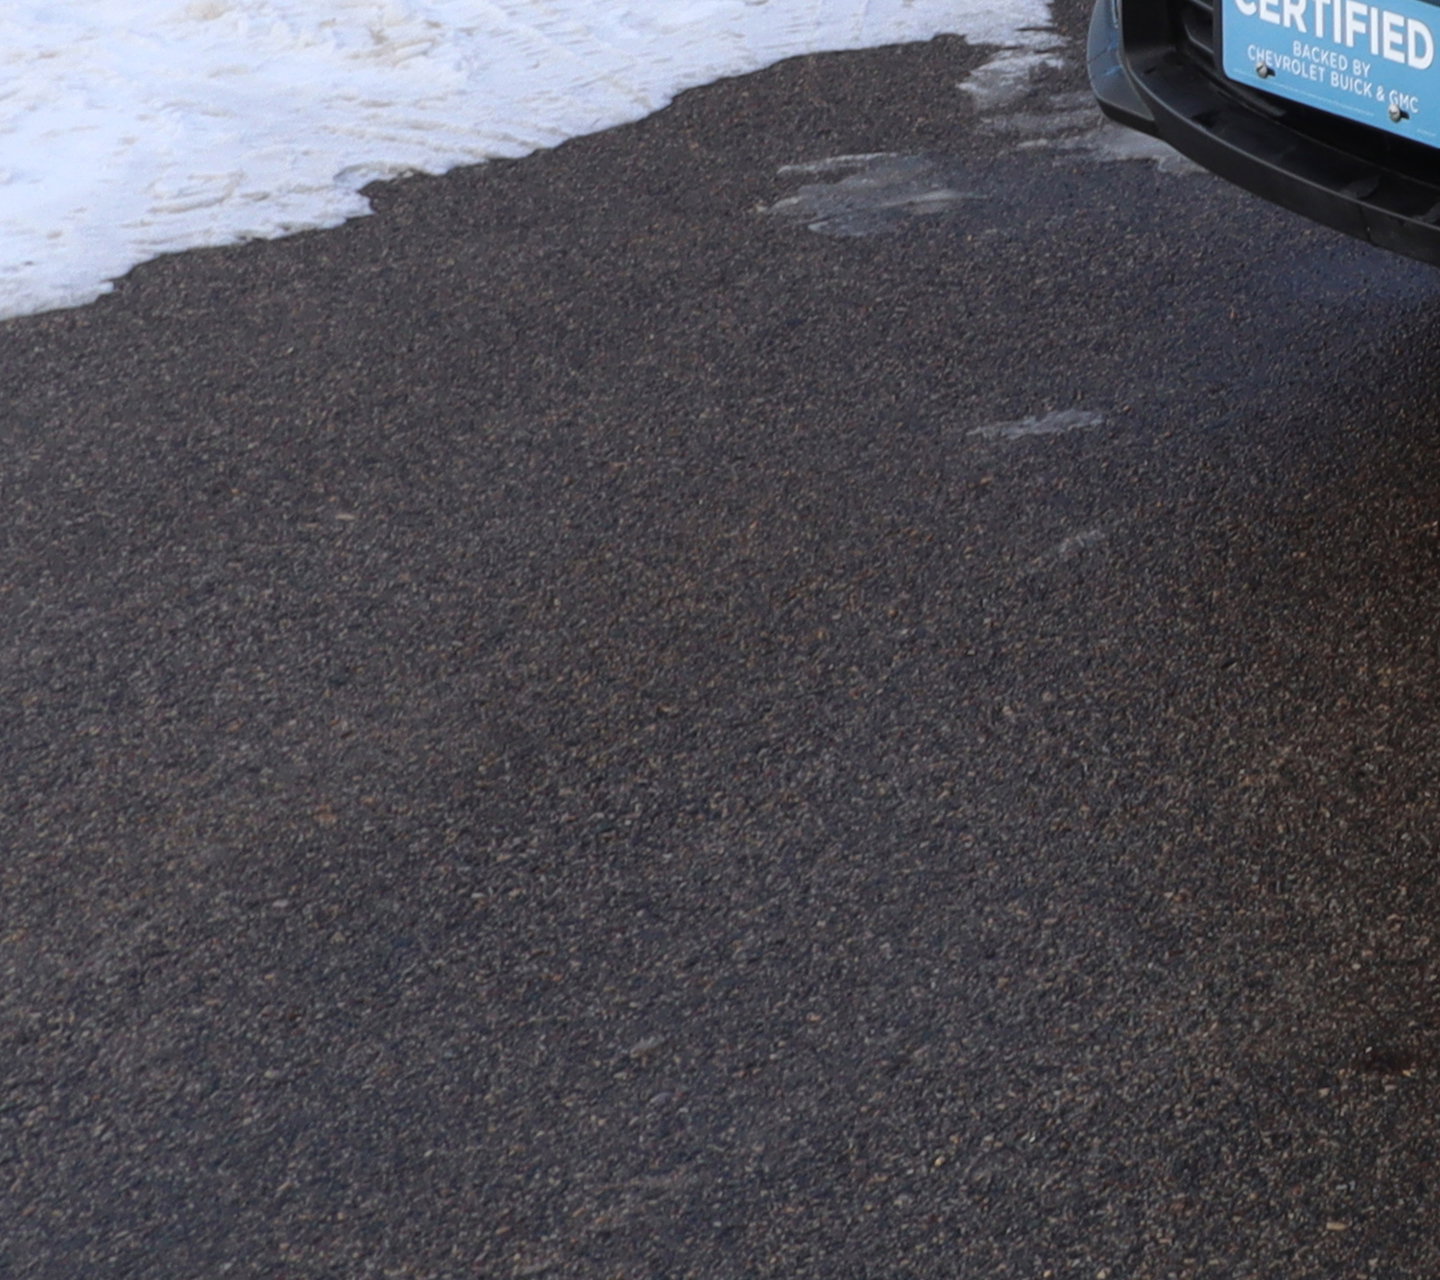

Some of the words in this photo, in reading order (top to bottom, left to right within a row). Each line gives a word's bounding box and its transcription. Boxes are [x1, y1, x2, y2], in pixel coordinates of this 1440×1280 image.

[1247, 44, 1326, 83] CHEVROLET
[1331, 70, 1373, 99] BUICK
[1375, 85, 1385, 101] &
[1388, 89, 1419, 114] GMC
[1293, 40, 1348, 72] BACKED
[1353, 58, 1371, 79] BY
